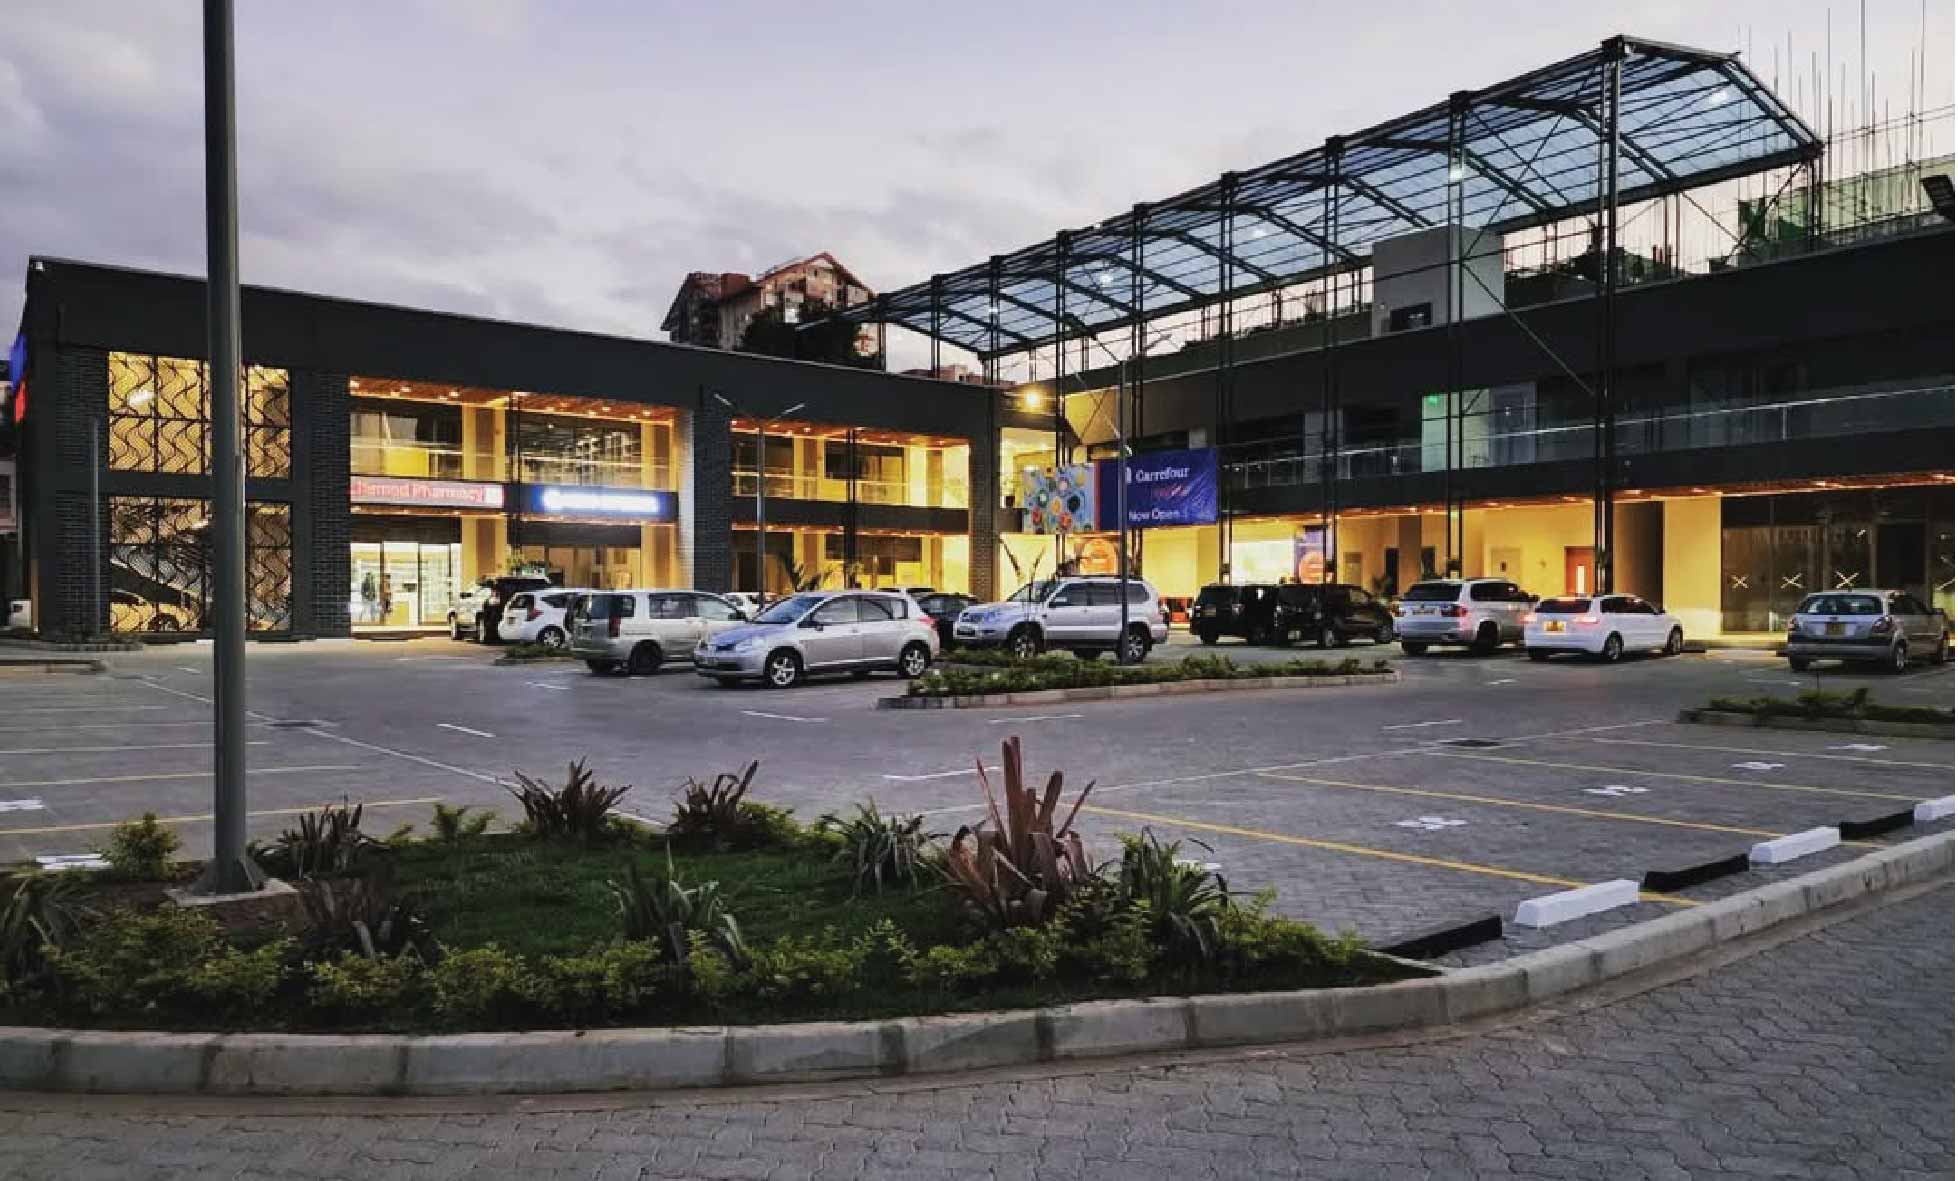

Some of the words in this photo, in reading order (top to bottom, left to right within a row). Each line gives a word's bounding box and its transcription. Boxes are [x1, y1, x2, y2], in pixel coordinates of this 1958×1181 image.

[1136, 467, 1190, 482] Carrefour
[412, 483, 483, 503] Pharmacy
[1128, 510, 1149, 519] Now
[1152, 508, 1180, 521] Open
